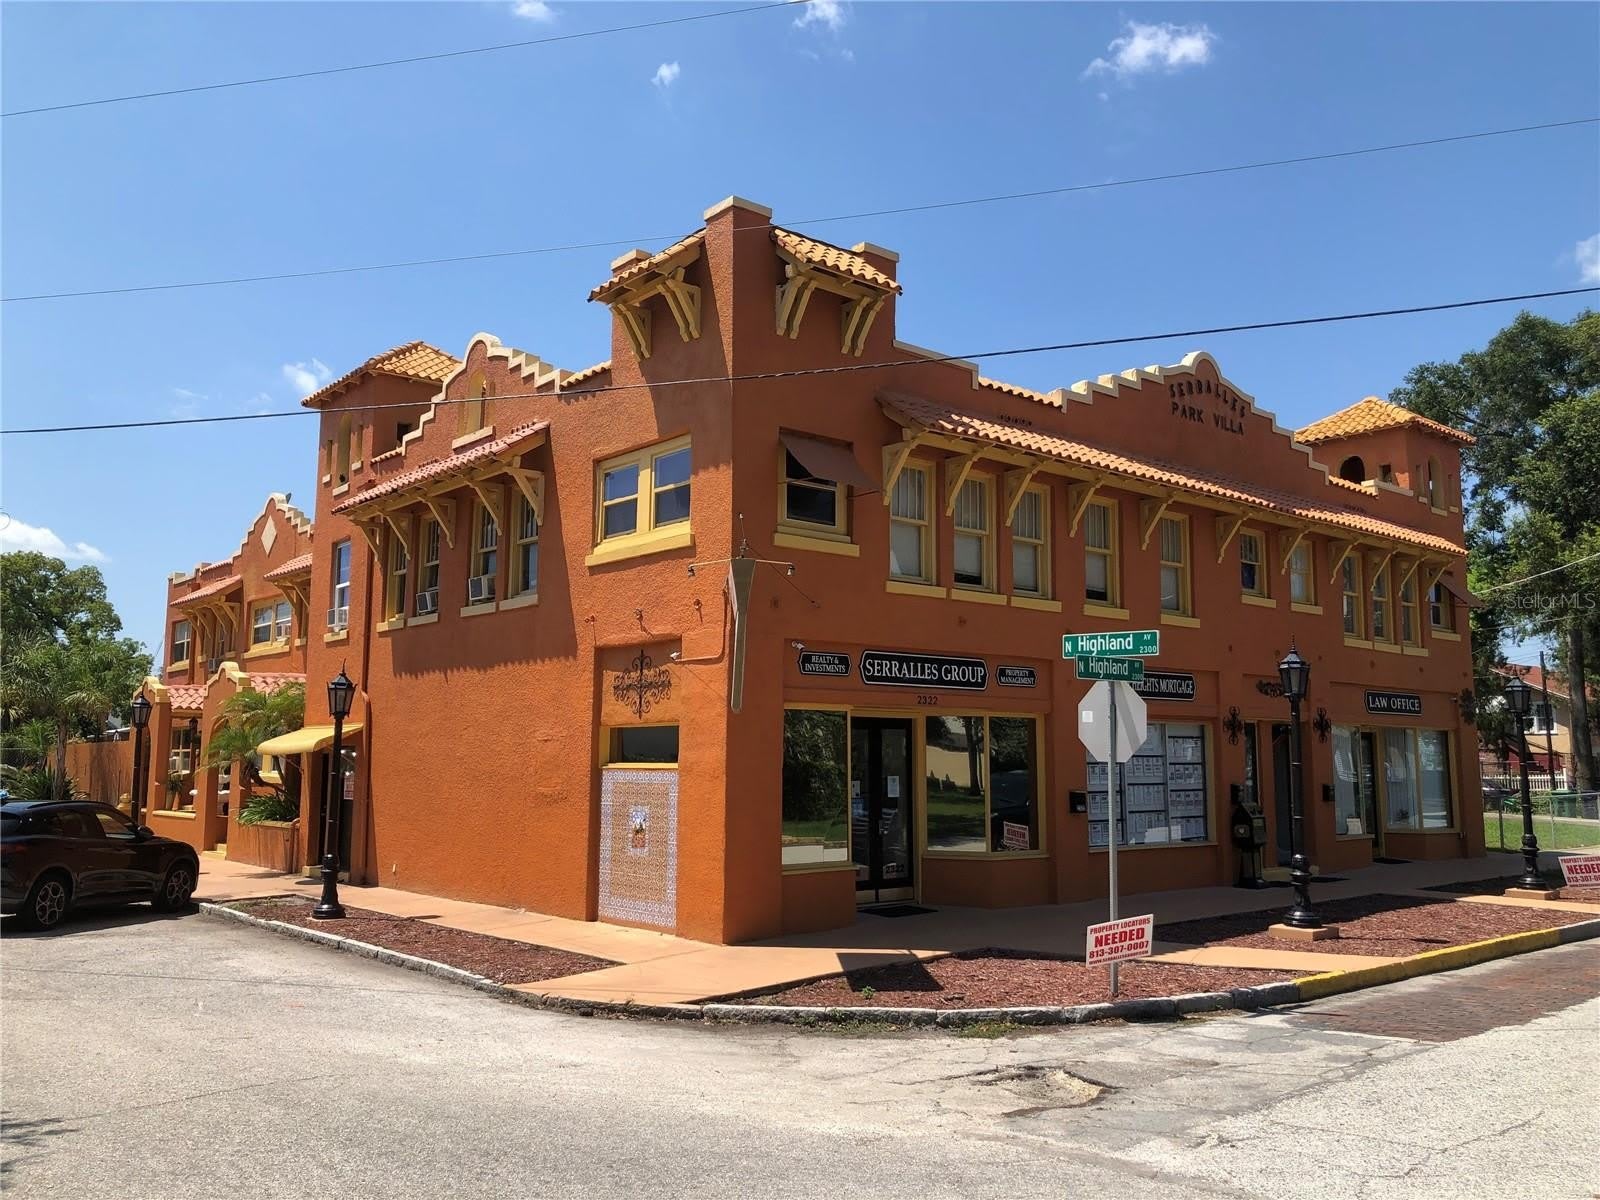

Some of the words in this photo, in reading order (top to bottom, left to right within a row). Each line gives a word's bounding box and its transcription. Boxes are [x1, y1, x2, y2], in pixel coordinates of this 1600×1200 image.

[1169, 379, 1245, 418] SERRALLES
[1171, 401, 1204, 424] PARK
[1212, 413, 1244, 436] VILLA
[1065, 641, 1072, 653] N
[1078, 633, 1133, 656] Highland
[1139, 645, 1157, 654] 2300
[805, 663, 846, 673] INVESTMENTS
[811, 655, 833, 664] REALTY
[1078, 660, 1084, 672] N
[1089, 656, 1128, 678] Highland
[865, 659, 939, 680] SERRALLES
[941, 664, 985, 682] GROUP
[1005, 669, 1029, 677] PROPERTY
[1000, 676, 1034, 685] MANAGEMENT
[1160, 679, 1194, 694] MORTGAGE
[917, 695, 938, 705] 2322
[1369, 695, 1388, 708] LAW
[1390, 697, 1420, 711] OFFICE
[1090, 923, 1119, 935] PROPERTY
[1120, 917, 1151, 929] LOCATORS
[1094, 927, 1145, 948] NEEDED
[1089, 940, 1149, 959] 813-307-0007
